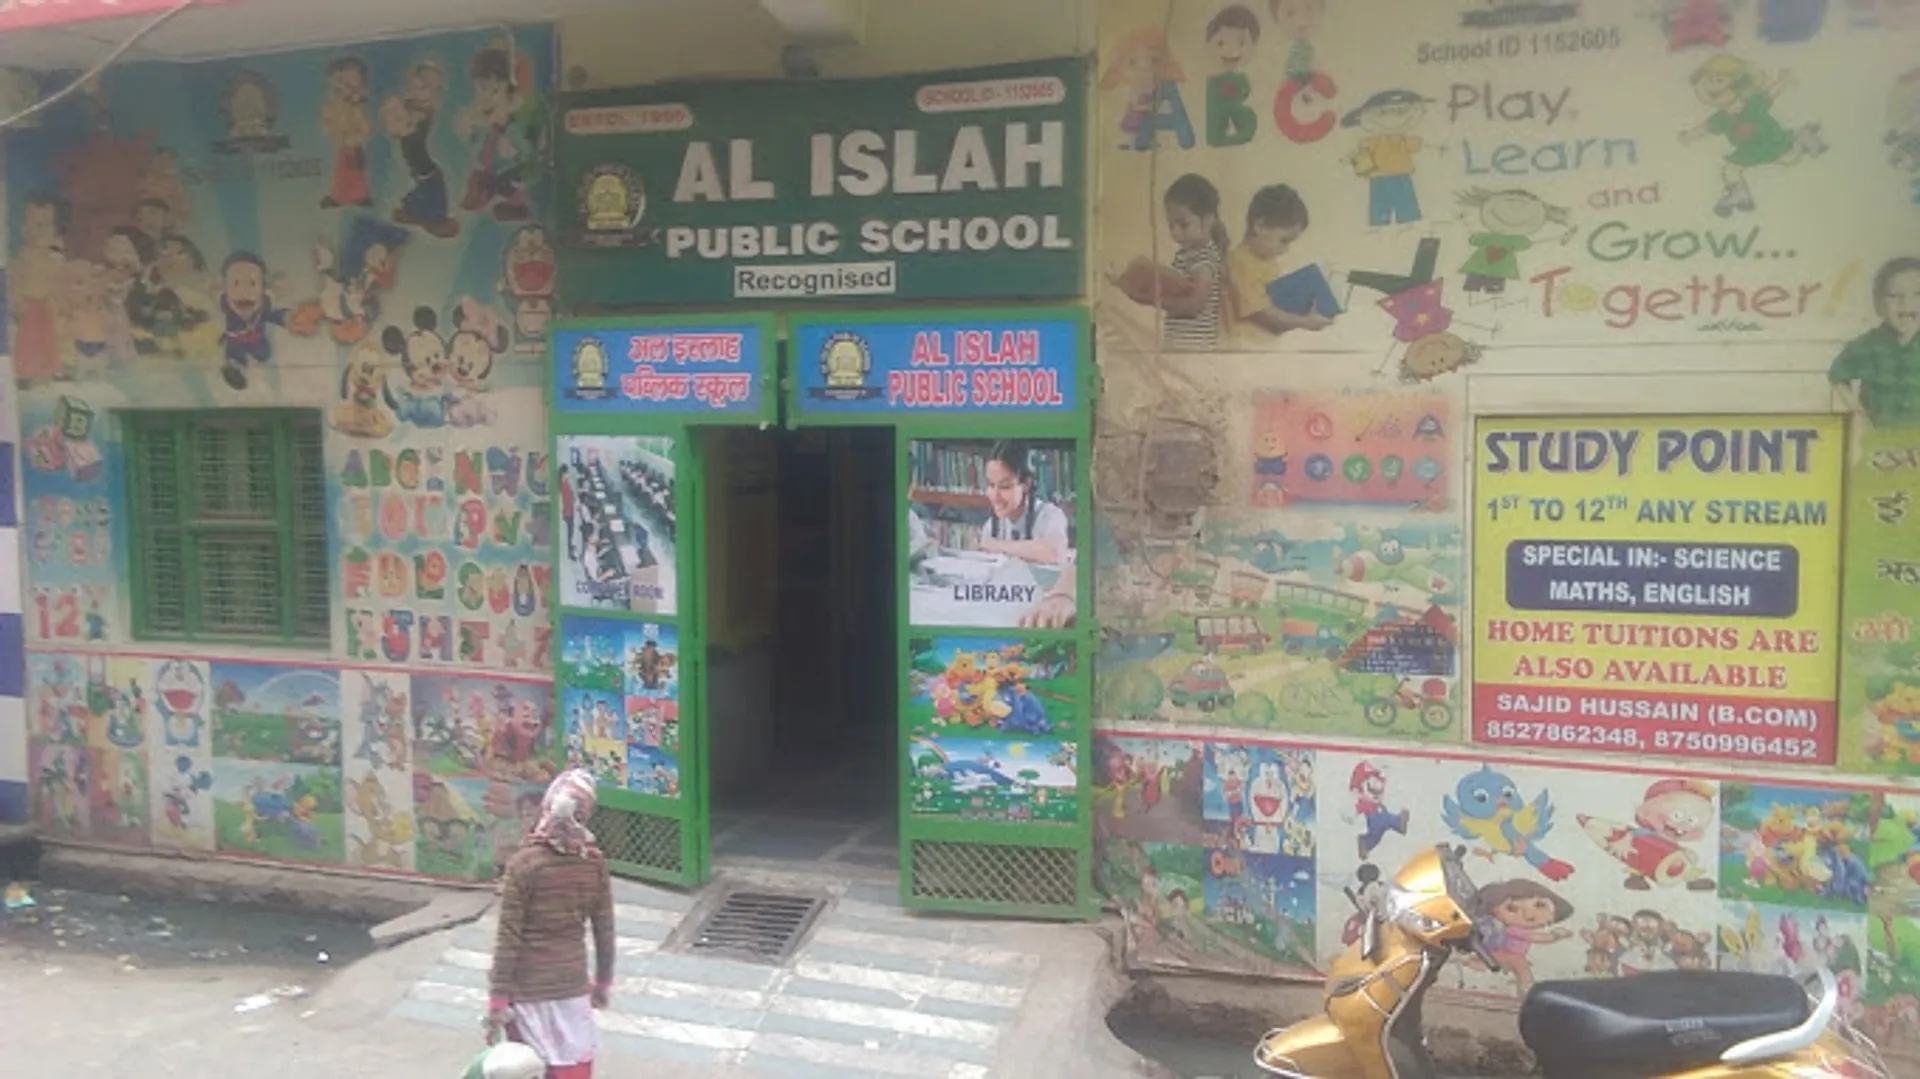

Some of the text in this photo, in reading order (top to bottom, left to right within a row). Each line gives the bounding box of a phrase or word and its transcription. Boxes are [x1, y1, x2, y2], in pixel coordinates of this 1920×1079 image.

[1417, 40, 1492, 64] School
[1499, 35, 1520, 58] ID
[1135, 70, 1338, 150] A B C
[672, 139, 776, 203] AL
[809, 120, 1065, 198] ISLAH
[1461, 136, 1638, 176] Learn
[1587, 181, 1660, 211] and
[665, 214, 1073, 260] PUBLIC SCHOOL
[1586, 220, 1797, 263] Grow...
[737, 266, 894, 297] Recognised
[629, 335, 670, 363] अल
[911, 330, 1039, 366] AL ISLAH
[888, 367, 1063, 407] PUBLIC SCHOOL
[1484, 429, 1644, 477] STUDY
[1656, 428, 1820, 475] POINT
[1529, 499, 1565, 522] TO
[1636, 499, 1697, 524] ANY
[1705, 499, 1828, 526] STREAM
[1522, 544, 1621, 567] SPECIAL
[1674, 548, 1783, 571] SCIENCE
[953, 583, 1036, 605] LIBRARY
[1549, 580, 1752, 607] MATHS, ENGLISH
[1487, 619, 1819, 653] HOME TUITIONS ARE
[1513, 655, 1788, 690] ALSO AVAILABLE
[1496, 693, 1818, 732] SAJID HUSSAIN (B.COM)
